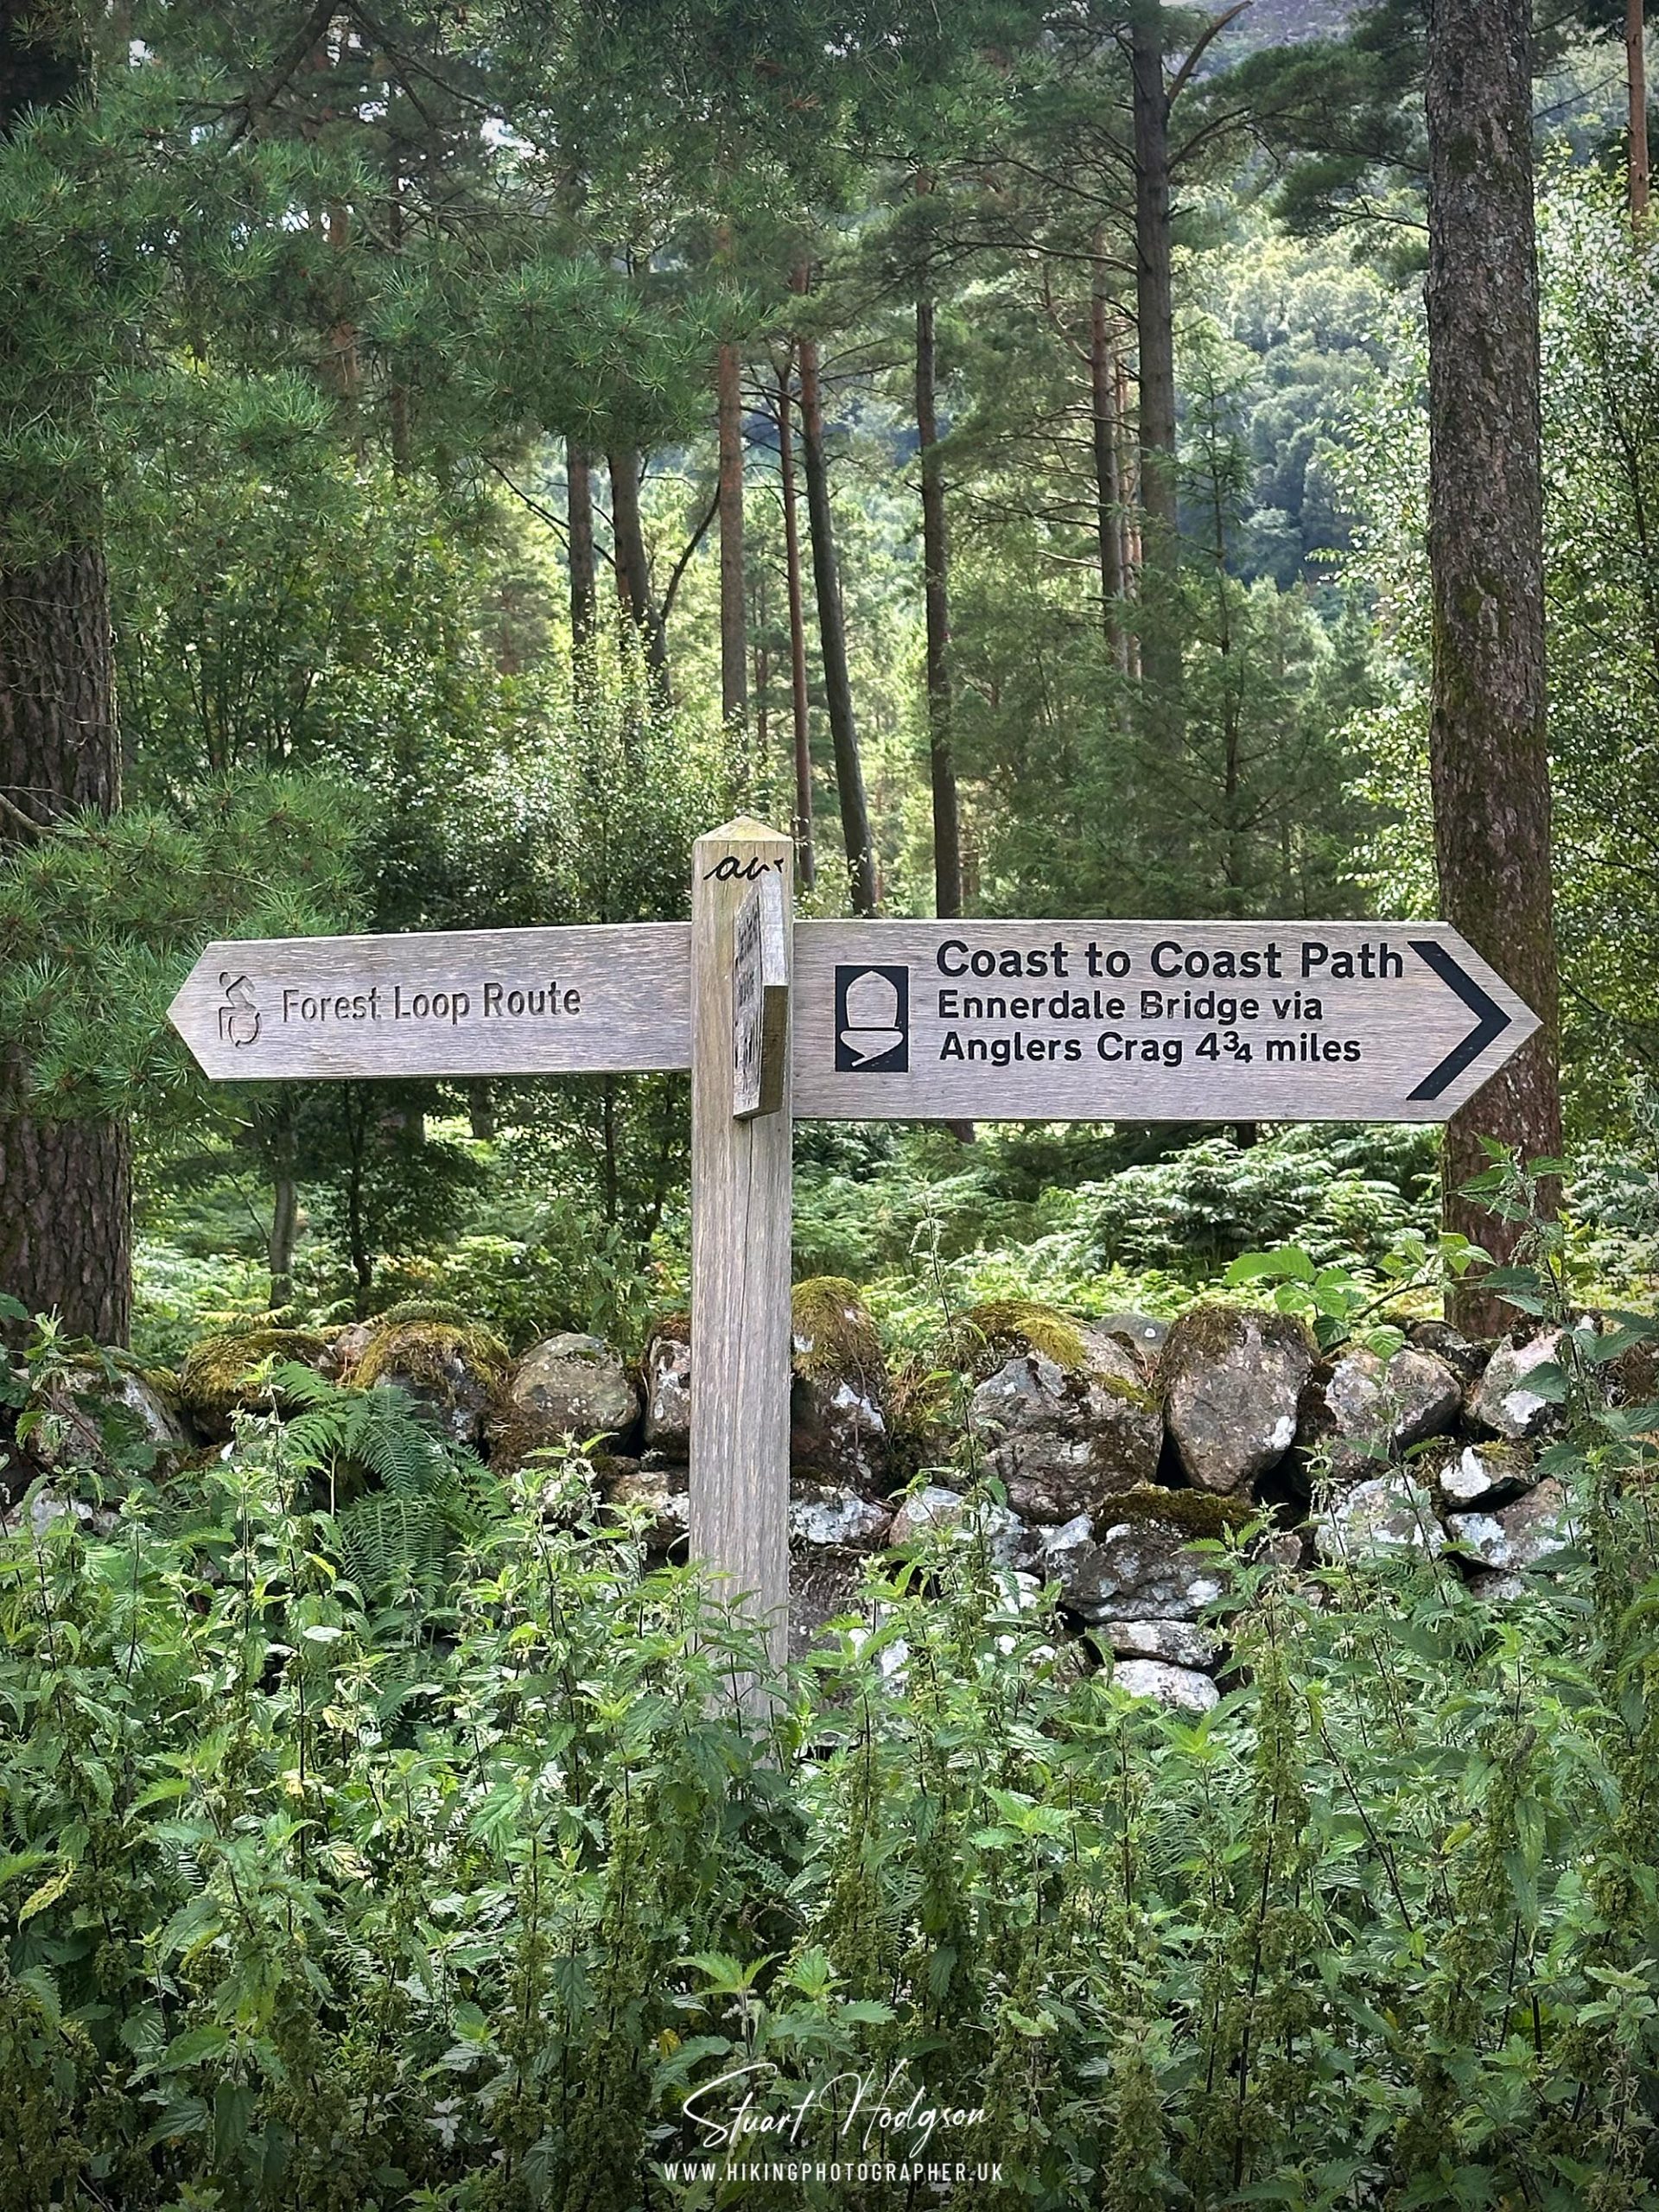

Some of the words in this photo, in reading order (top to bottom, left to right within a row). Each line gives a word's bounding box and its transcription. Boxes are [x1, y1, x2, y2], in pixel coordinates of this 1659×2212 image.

[937, 939, 1069, 977] Coast
[1084, 941, 1131, 977] to
[1150, 939, 1282, 977] Coast
[1301, 941, 1404, 978] Path
[283, 987, 381, 1022] Forest
[395, 985, 470, 1025] Loop
[484, 982, 582, 1016] Route
[938, 989, 1125, 1020] Ennerdale
[1141, 990, 1259, 1026] Bridge
[1272, 991, 1322, 1020] via
[940, 1032, 1082, 1067] Anglers
[1096, 1032, 1184, 1067] Crag
[1266, 1032, 1361, 1062] miles
